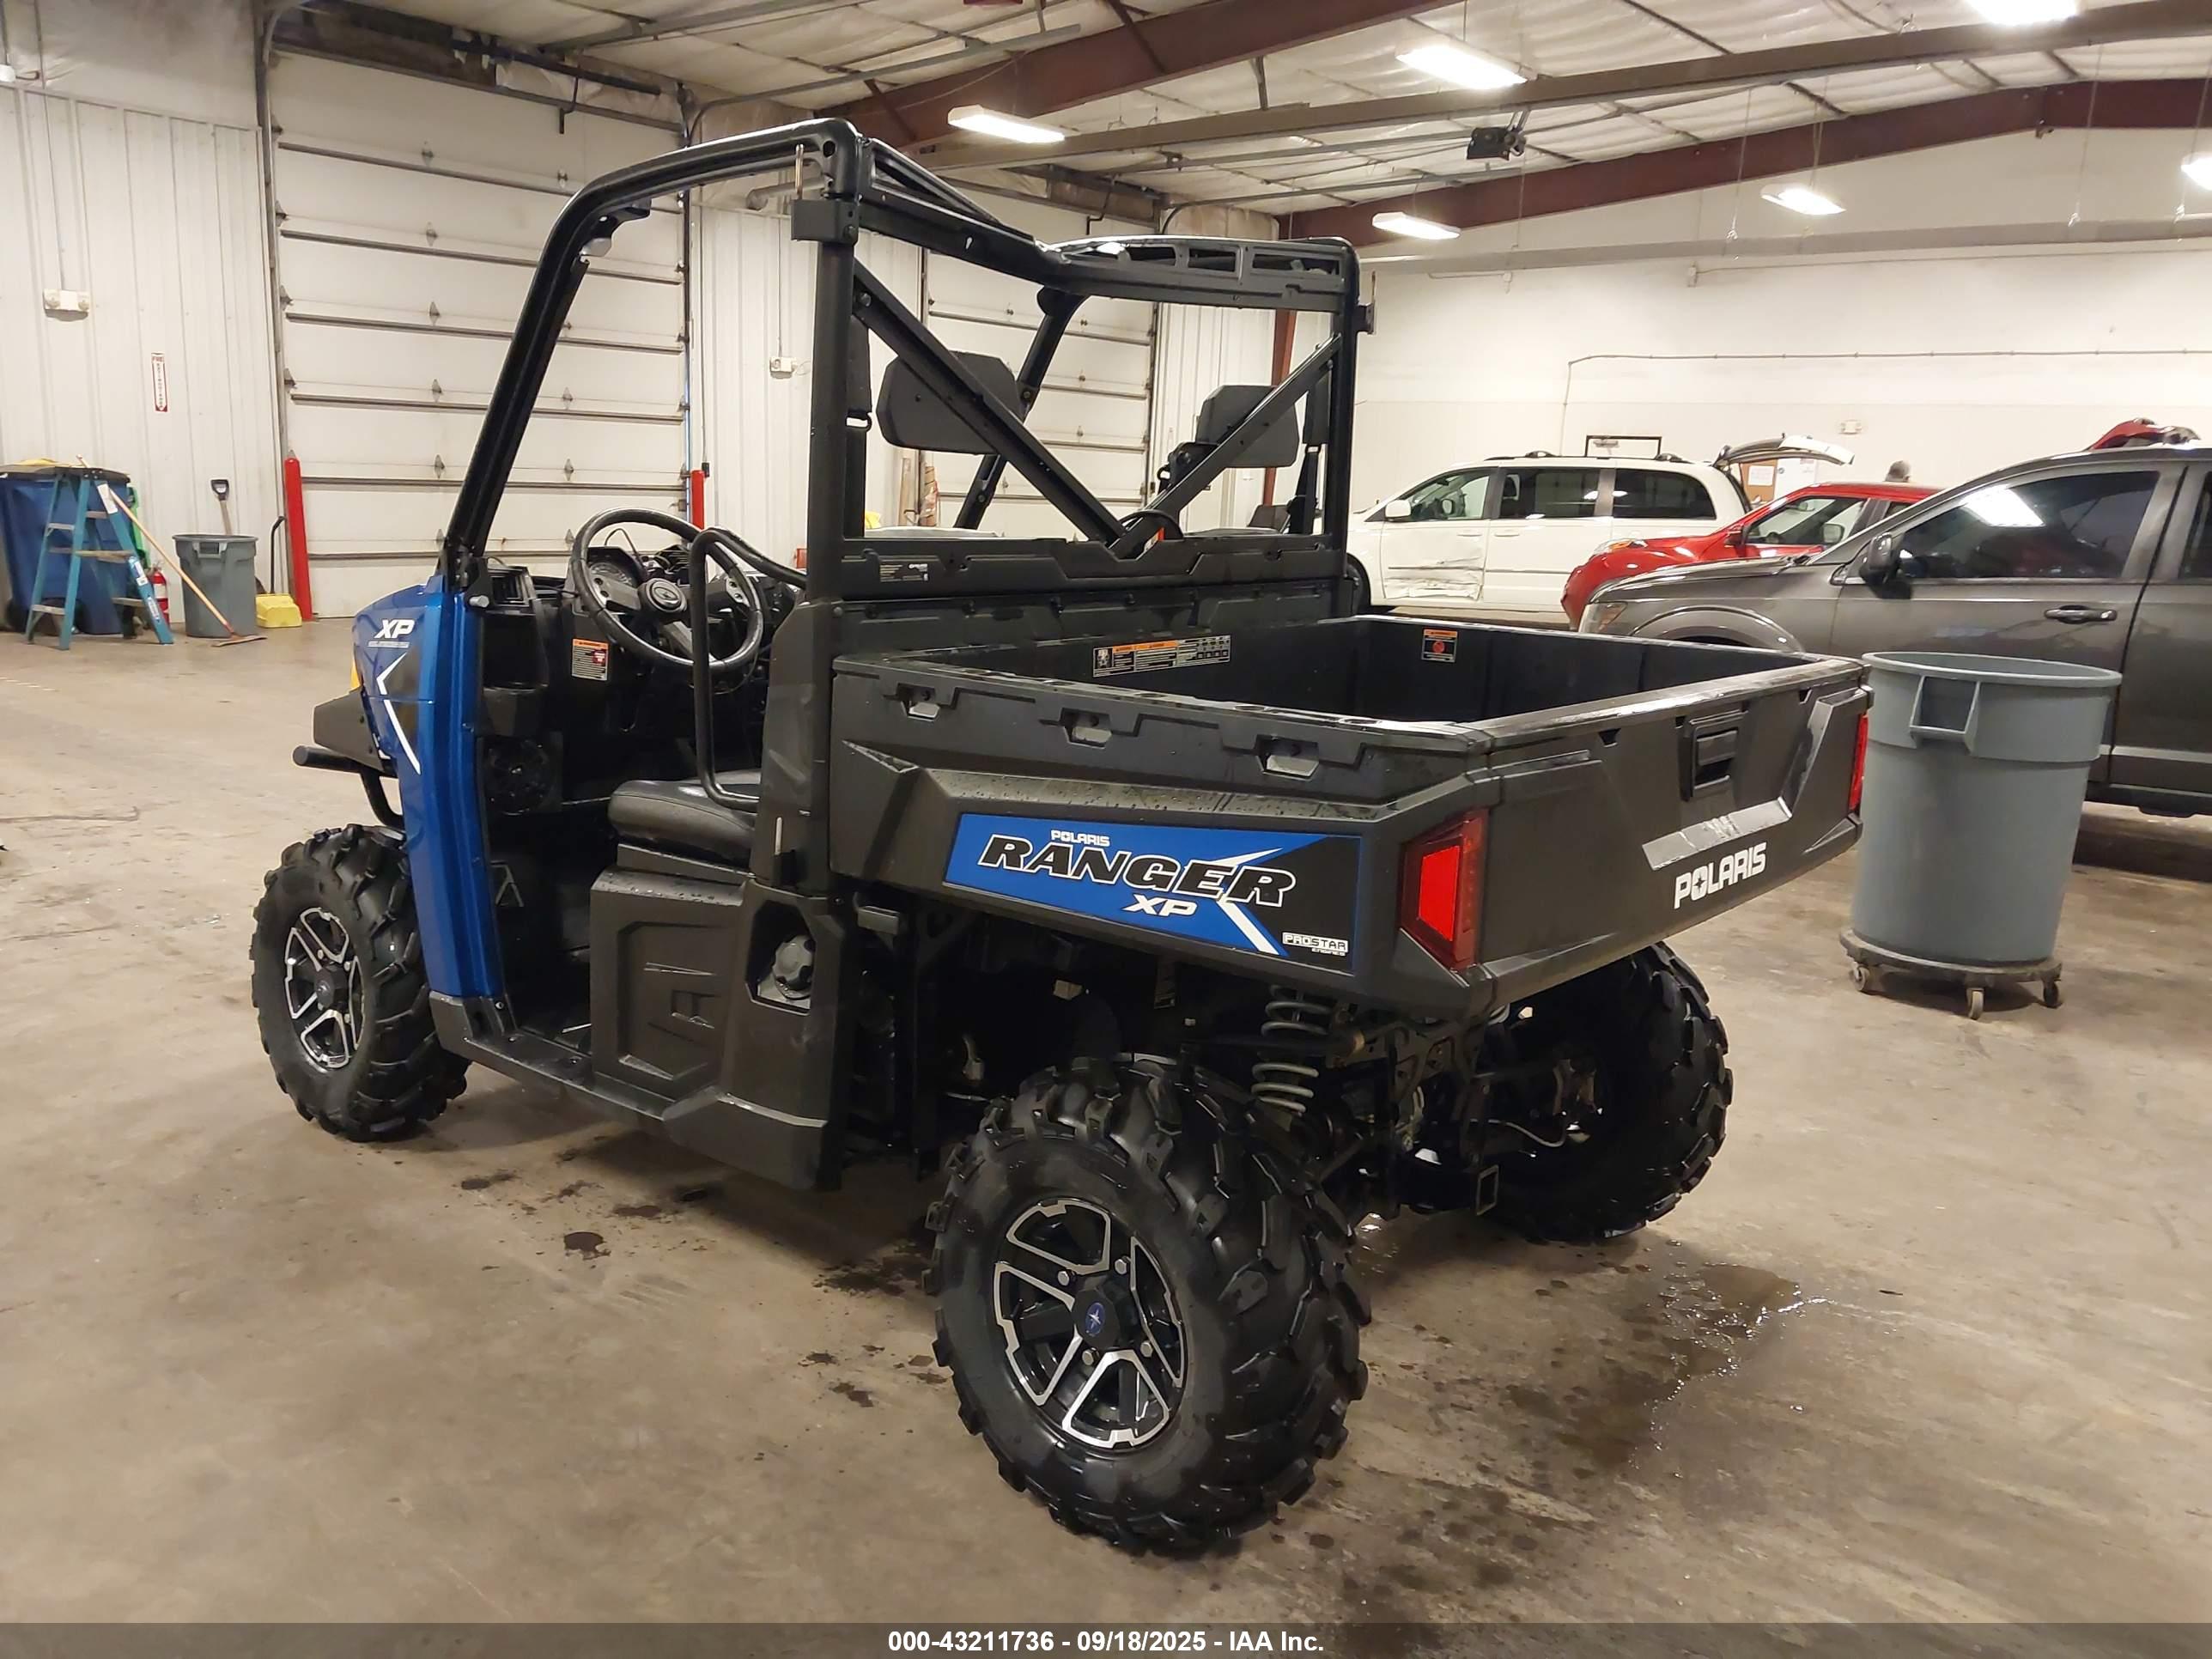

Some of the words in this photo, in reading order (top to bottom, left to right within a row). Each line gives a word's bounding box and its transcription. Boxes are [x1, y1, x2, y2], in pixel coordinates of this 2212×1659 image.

[374, 619, 415, 639] XP
[1051, 830, 1111, 848] POLARIS
[977, 834, 1297, 908] RANGER
[1674, 842, 1767, 909] POLARIS
[1121, 893, 1198, 917] XP
[1283, 933, 1347, 952] PROSTAR
